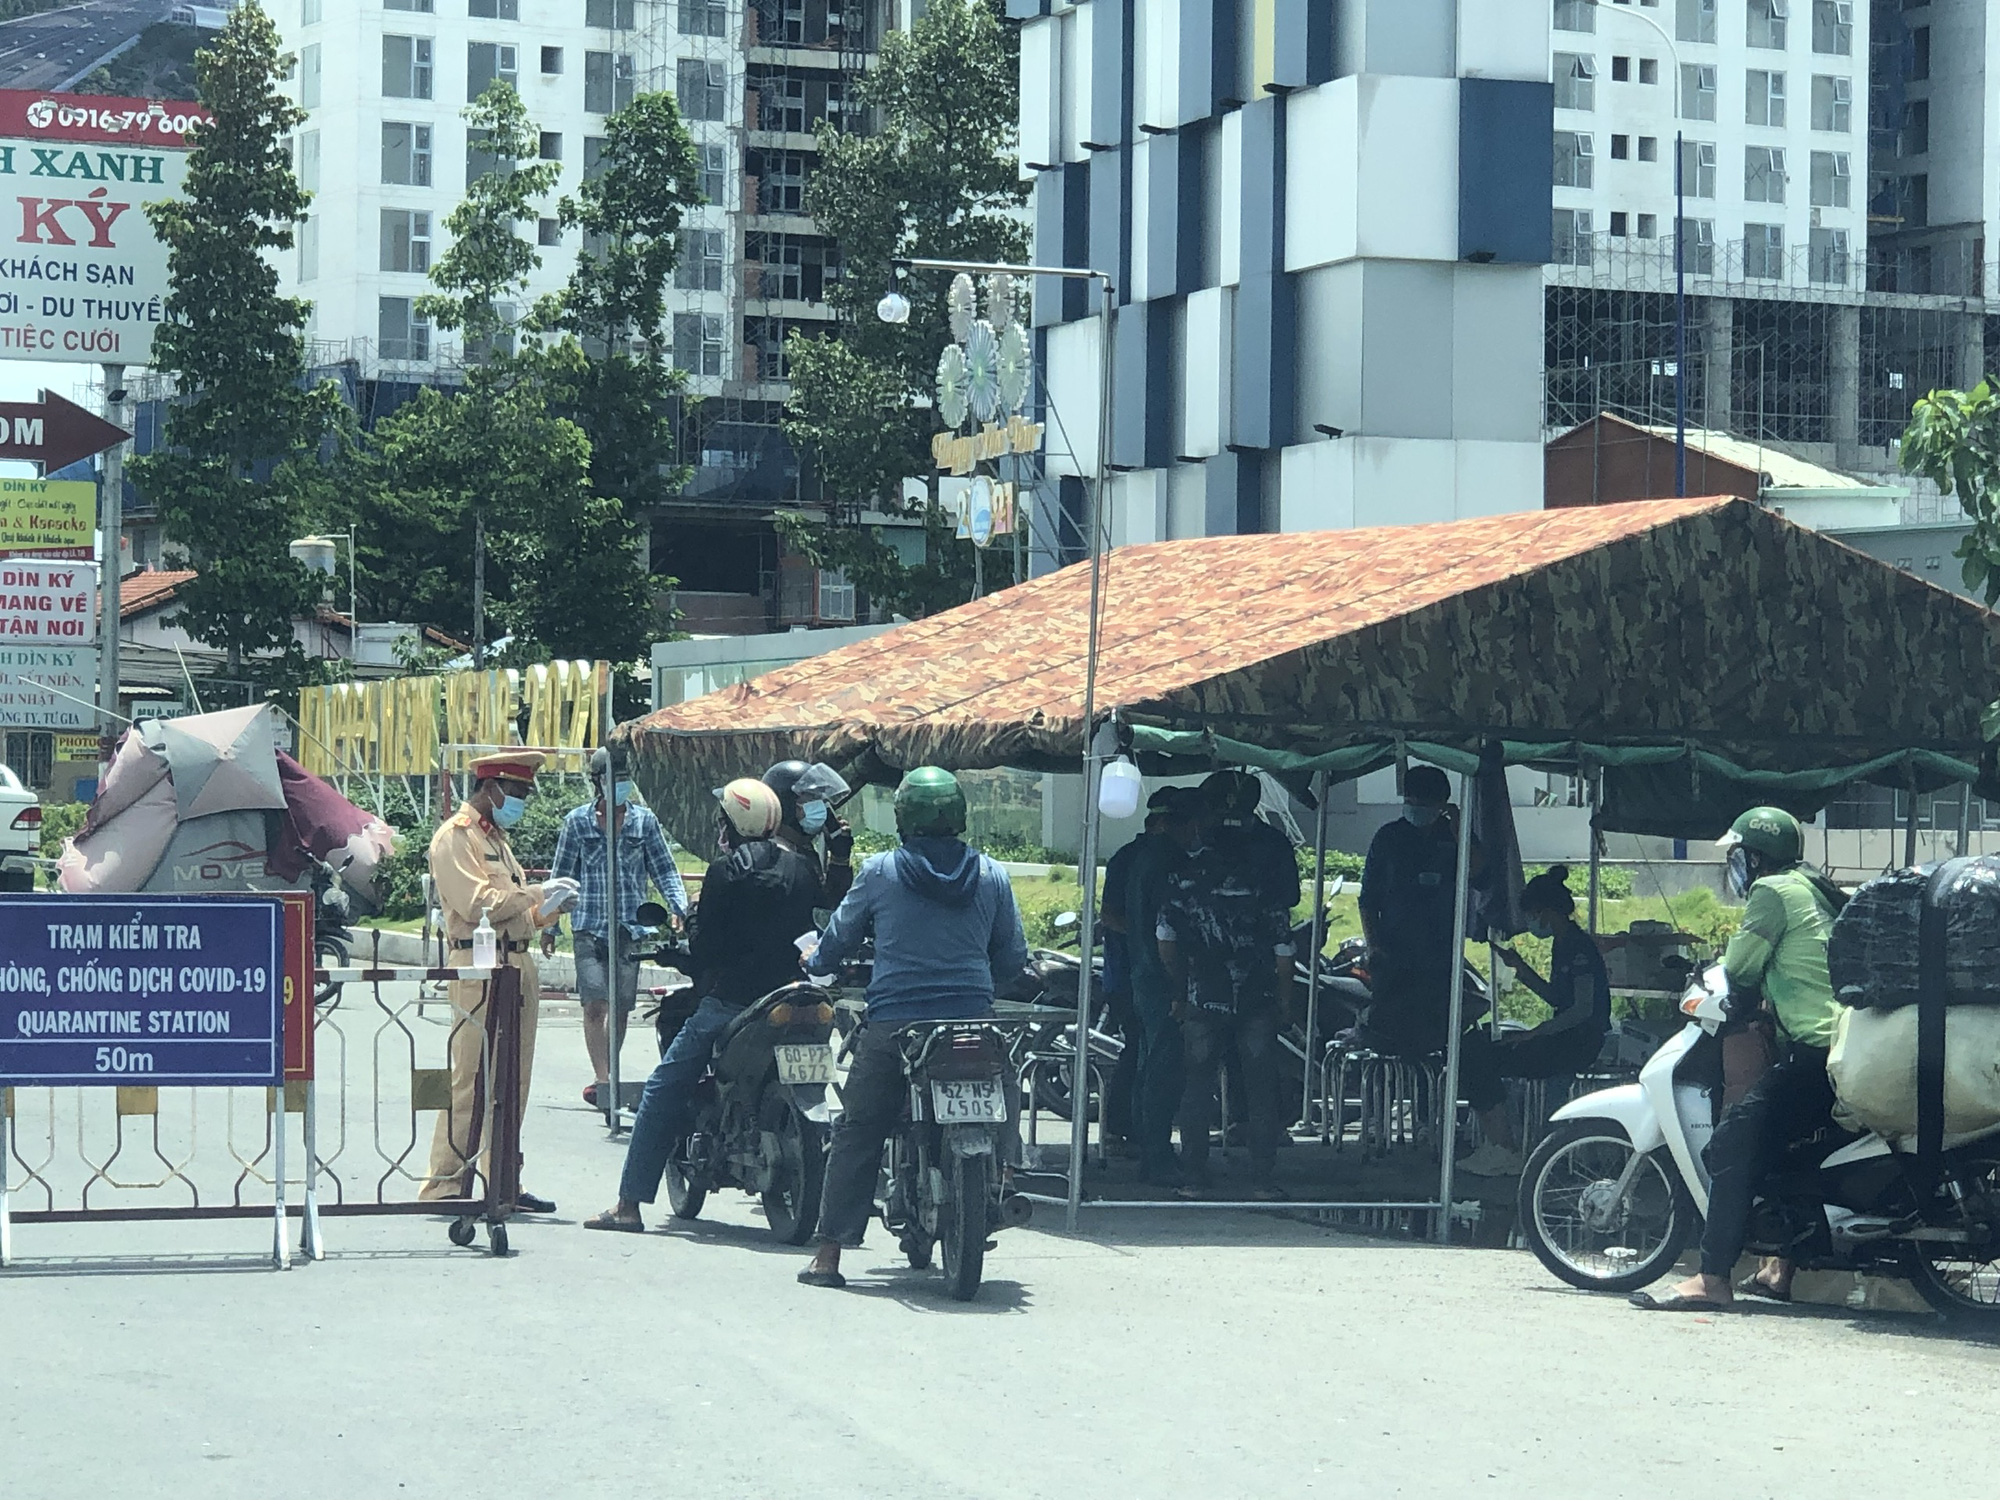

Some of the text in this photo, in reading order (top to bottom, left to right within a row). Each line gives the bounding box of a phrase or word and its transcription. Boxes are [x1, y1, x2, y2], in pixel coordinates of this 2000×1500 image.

[122, 111, 151, 131] 79
[30, 148, 165, 184] XANH
[16, 186, 131, 248] KÝ
[86, 263, 134, 288] SẠN
[42, 296, 74, 317] DU
[1, 323, 120, 353] TIỆC CƯỚI
[29, 514, 87, 532] Karaoke
[3, 567, 76, 588] DÌN KÝ
[60, 591, 88, 613] VỀ
[0, 615, 85, 638] TẬN NƠI
[17, 649, 48, 666] DÌN
[52, 650, 77, 667] KÝ
[0, 690, 56, 707] H NHẬT
[60, 712, 80, 725] GIA
[1749, 818, 1781, 836] Grab
[173, 862, 265, 881] MOVE
[47, 912, 202, 955] TRẠM KIỂM TRA
[57, 957, 123, 993] CHỐNG
[129, 967, 173, 998] DỊCH
[179, 967, 266, 993] COVID-19
[17, 1010, 230, 1037] QUARANTINE STATION
[95, 1046, 154, 1072] 50m
[946, 1100, 994, 1117] 4505
